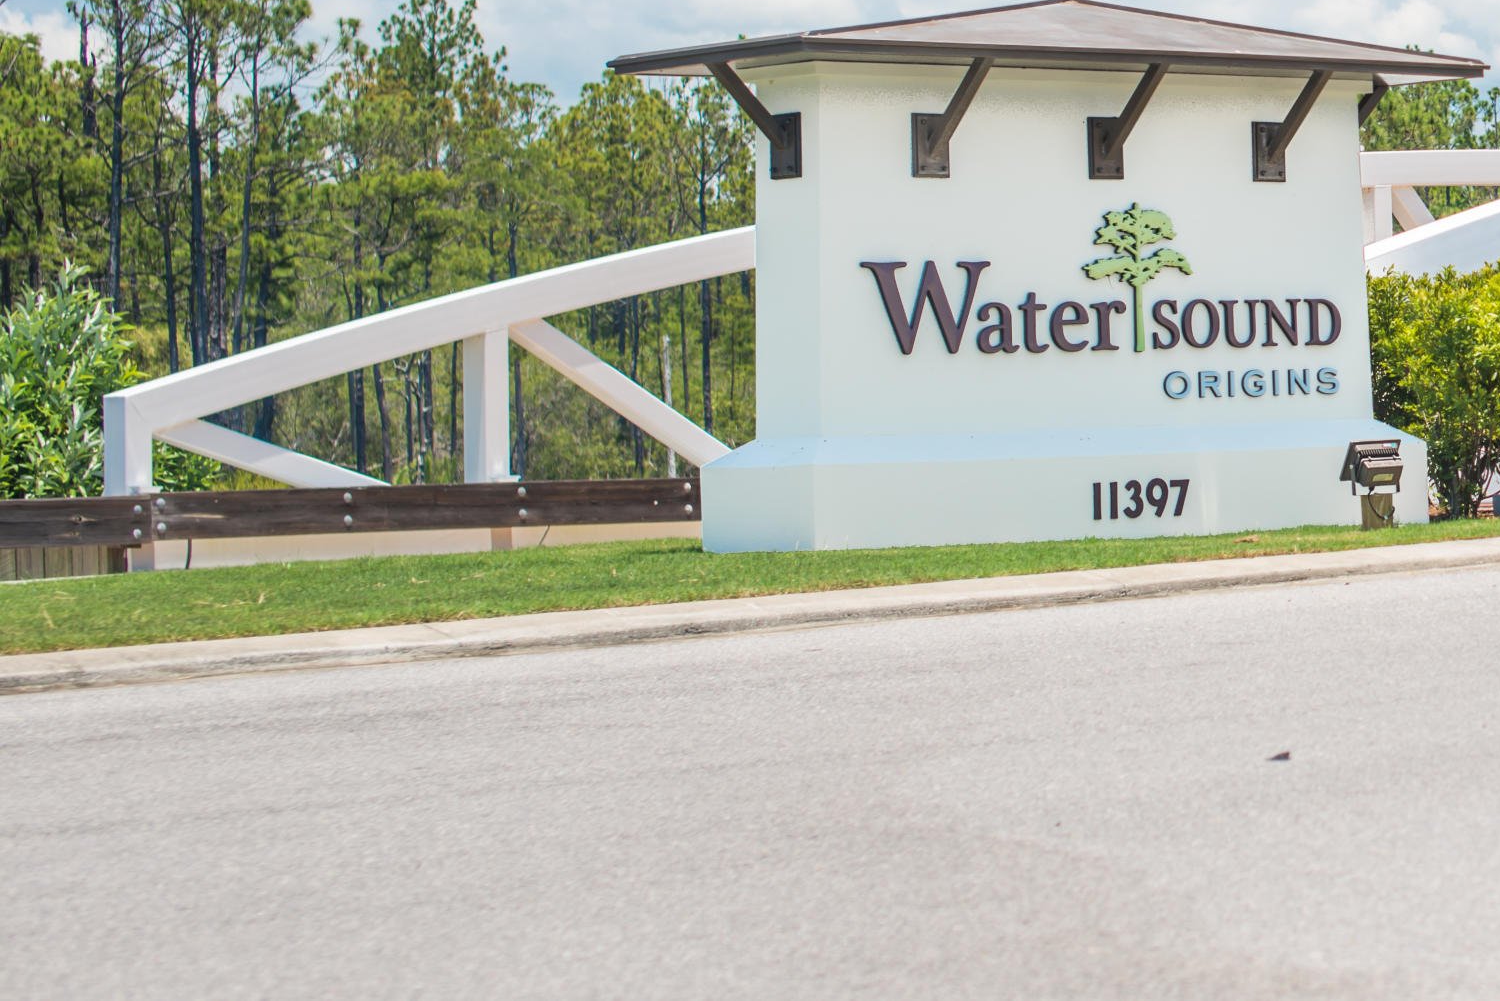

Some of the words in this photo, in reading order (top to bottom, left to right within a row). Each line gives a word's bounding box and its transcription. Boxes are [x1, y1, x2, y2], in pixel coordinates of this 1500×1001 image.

[860, 260, 1126, 355] Water
[1152, 298, 1341, 350] SOUND
[1163, 367, 1340, 400] ORIGINS
[1092, 477, 1190, 520] 11397
